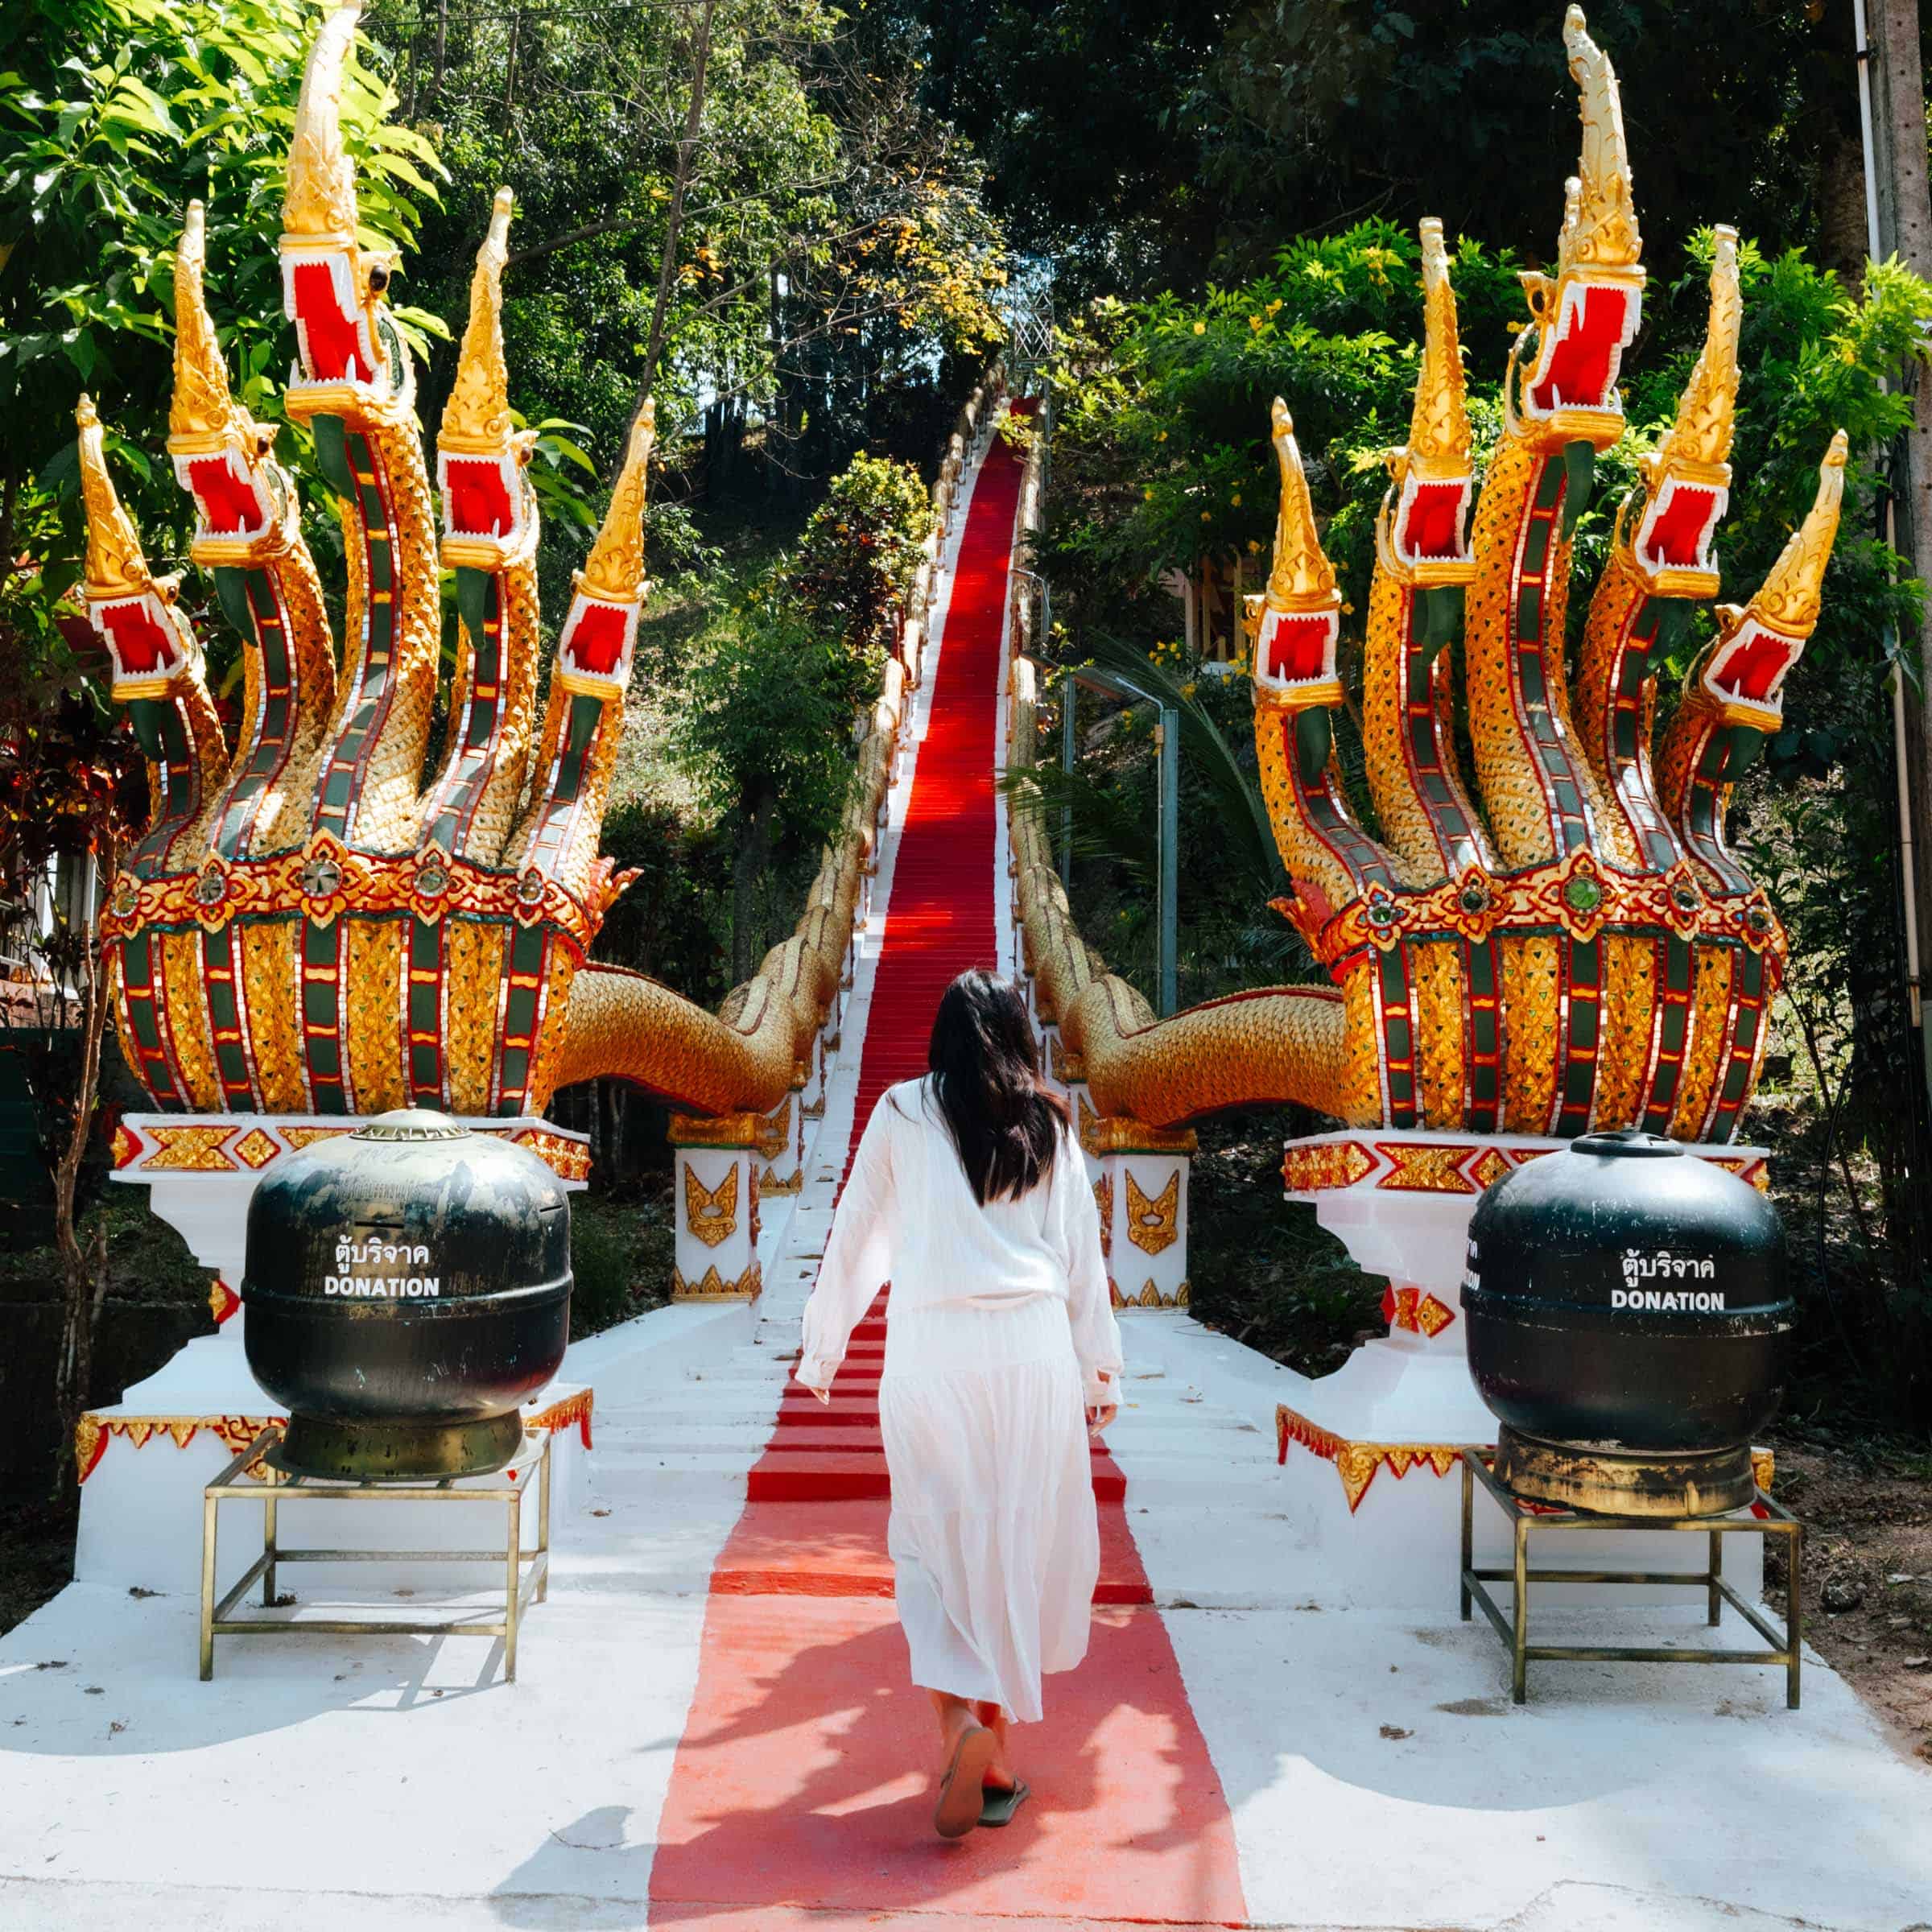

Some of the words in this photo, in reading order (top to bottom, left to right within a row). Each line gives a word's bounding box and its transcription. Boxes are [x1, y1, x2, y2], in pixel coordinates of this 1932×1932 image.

[336, 1235, 429, 1274] ตู้บริจาค
[1622, 1249, 1715, 1287] ตู้บริจาค
[324, 1276, 440, 1296] DONATION
[1611, 1290, 1724, 1311] DONATION
